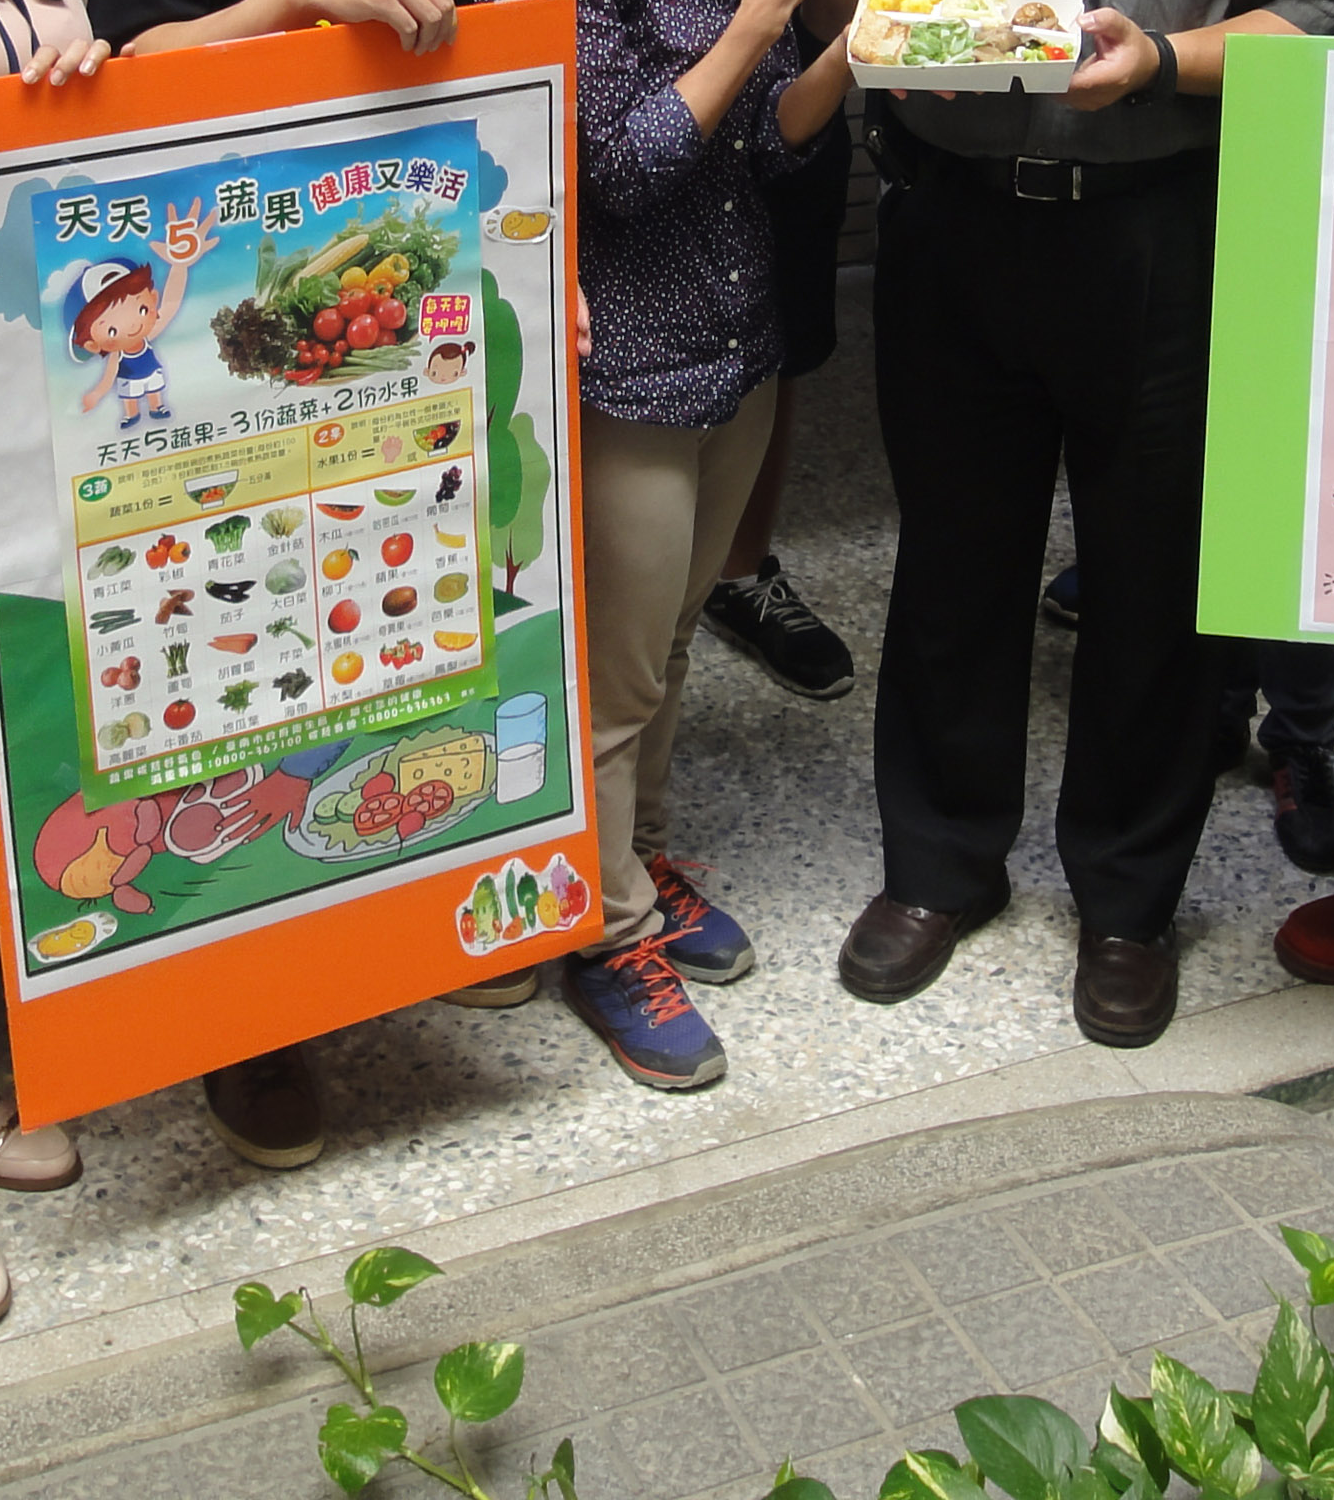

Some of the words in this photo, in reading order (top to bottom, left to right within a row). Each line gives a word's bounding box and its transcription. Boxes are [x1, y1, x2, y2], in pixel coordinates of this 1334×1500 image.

[308, 156, 469, 213] 健康又樂活
[81, 479, 110, 499] 3蔬
[318, 528, 343, 544] 木瓜
[267, 538, 306, 557] 金針菇
[207, 553, 247, 572] 青花菜
[92, 579, 133, 599] 青江菜
[270, 592, 308, 611] 大白菜
[219, 608, 246, 625] 茄子
[96, 637, 135, 657] 小黃瓜
[279, 648, 304, 664] 芹菜
